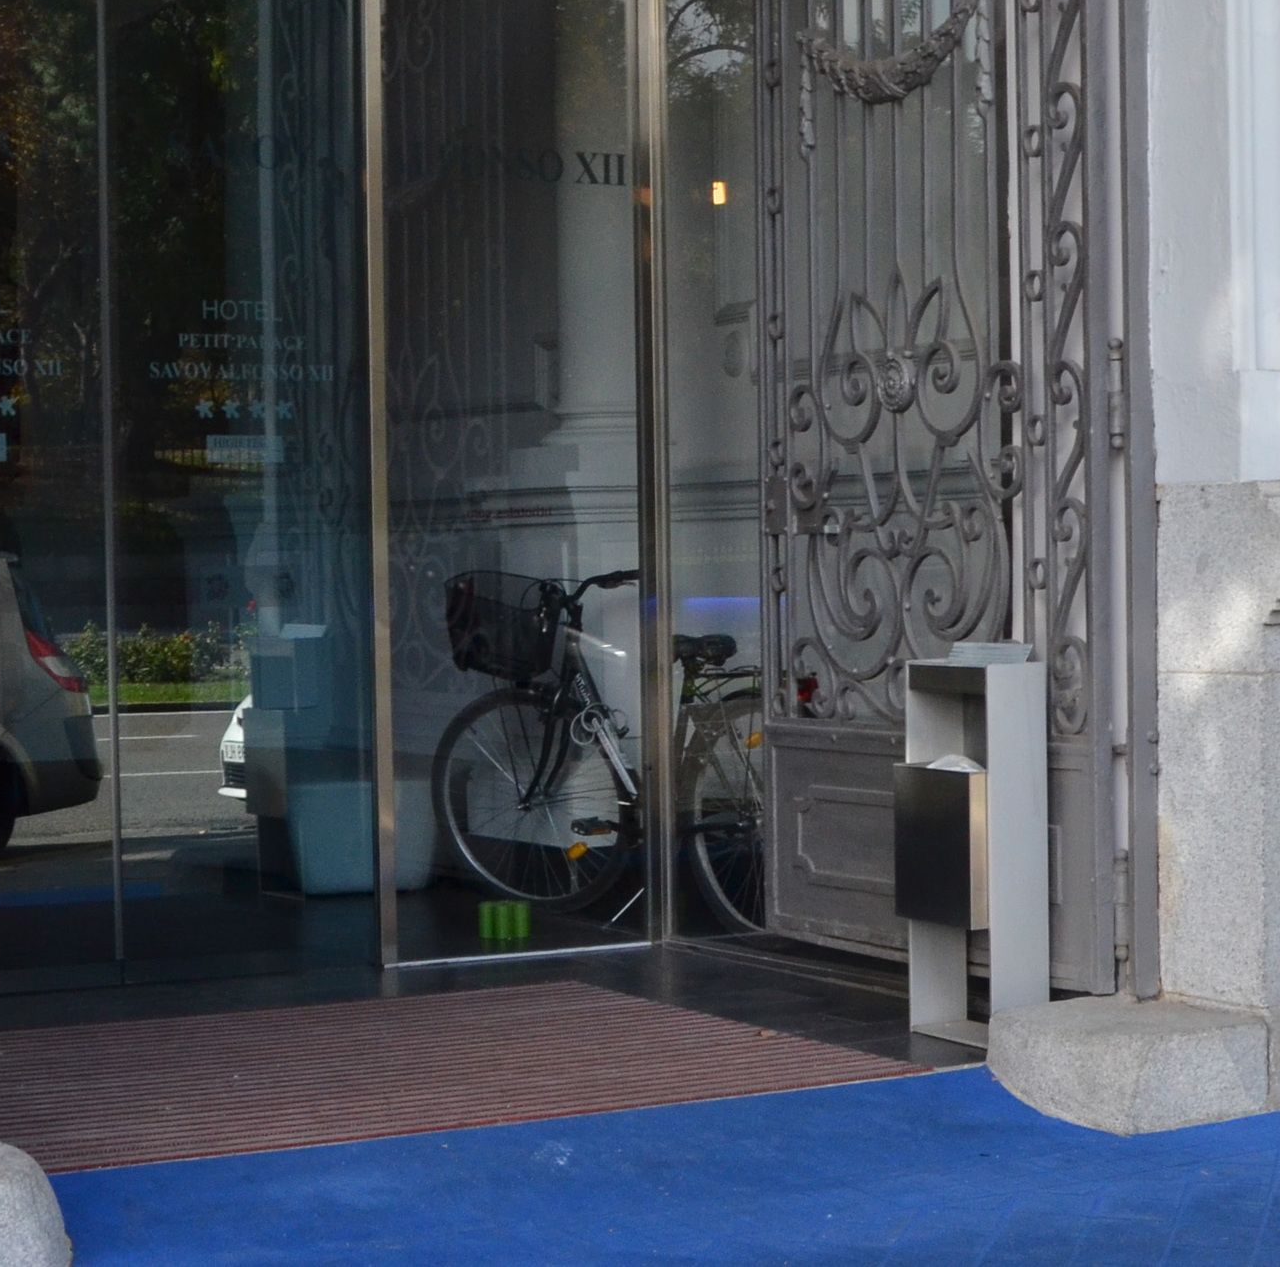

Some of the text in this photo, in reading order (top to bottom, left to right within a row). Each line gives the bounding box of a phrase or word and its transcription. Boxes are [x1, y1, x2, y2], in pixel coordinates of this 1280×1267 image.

[573, 151, 627, 186] XII
[202, 300, 283, 323] HOTEL
[178, 333, 307, 351] PETIT PALACE
[34, 359, 65, 377] XII
[149, 361, 212, 379] SAVOY
[308, 365, 335, 382] XII
